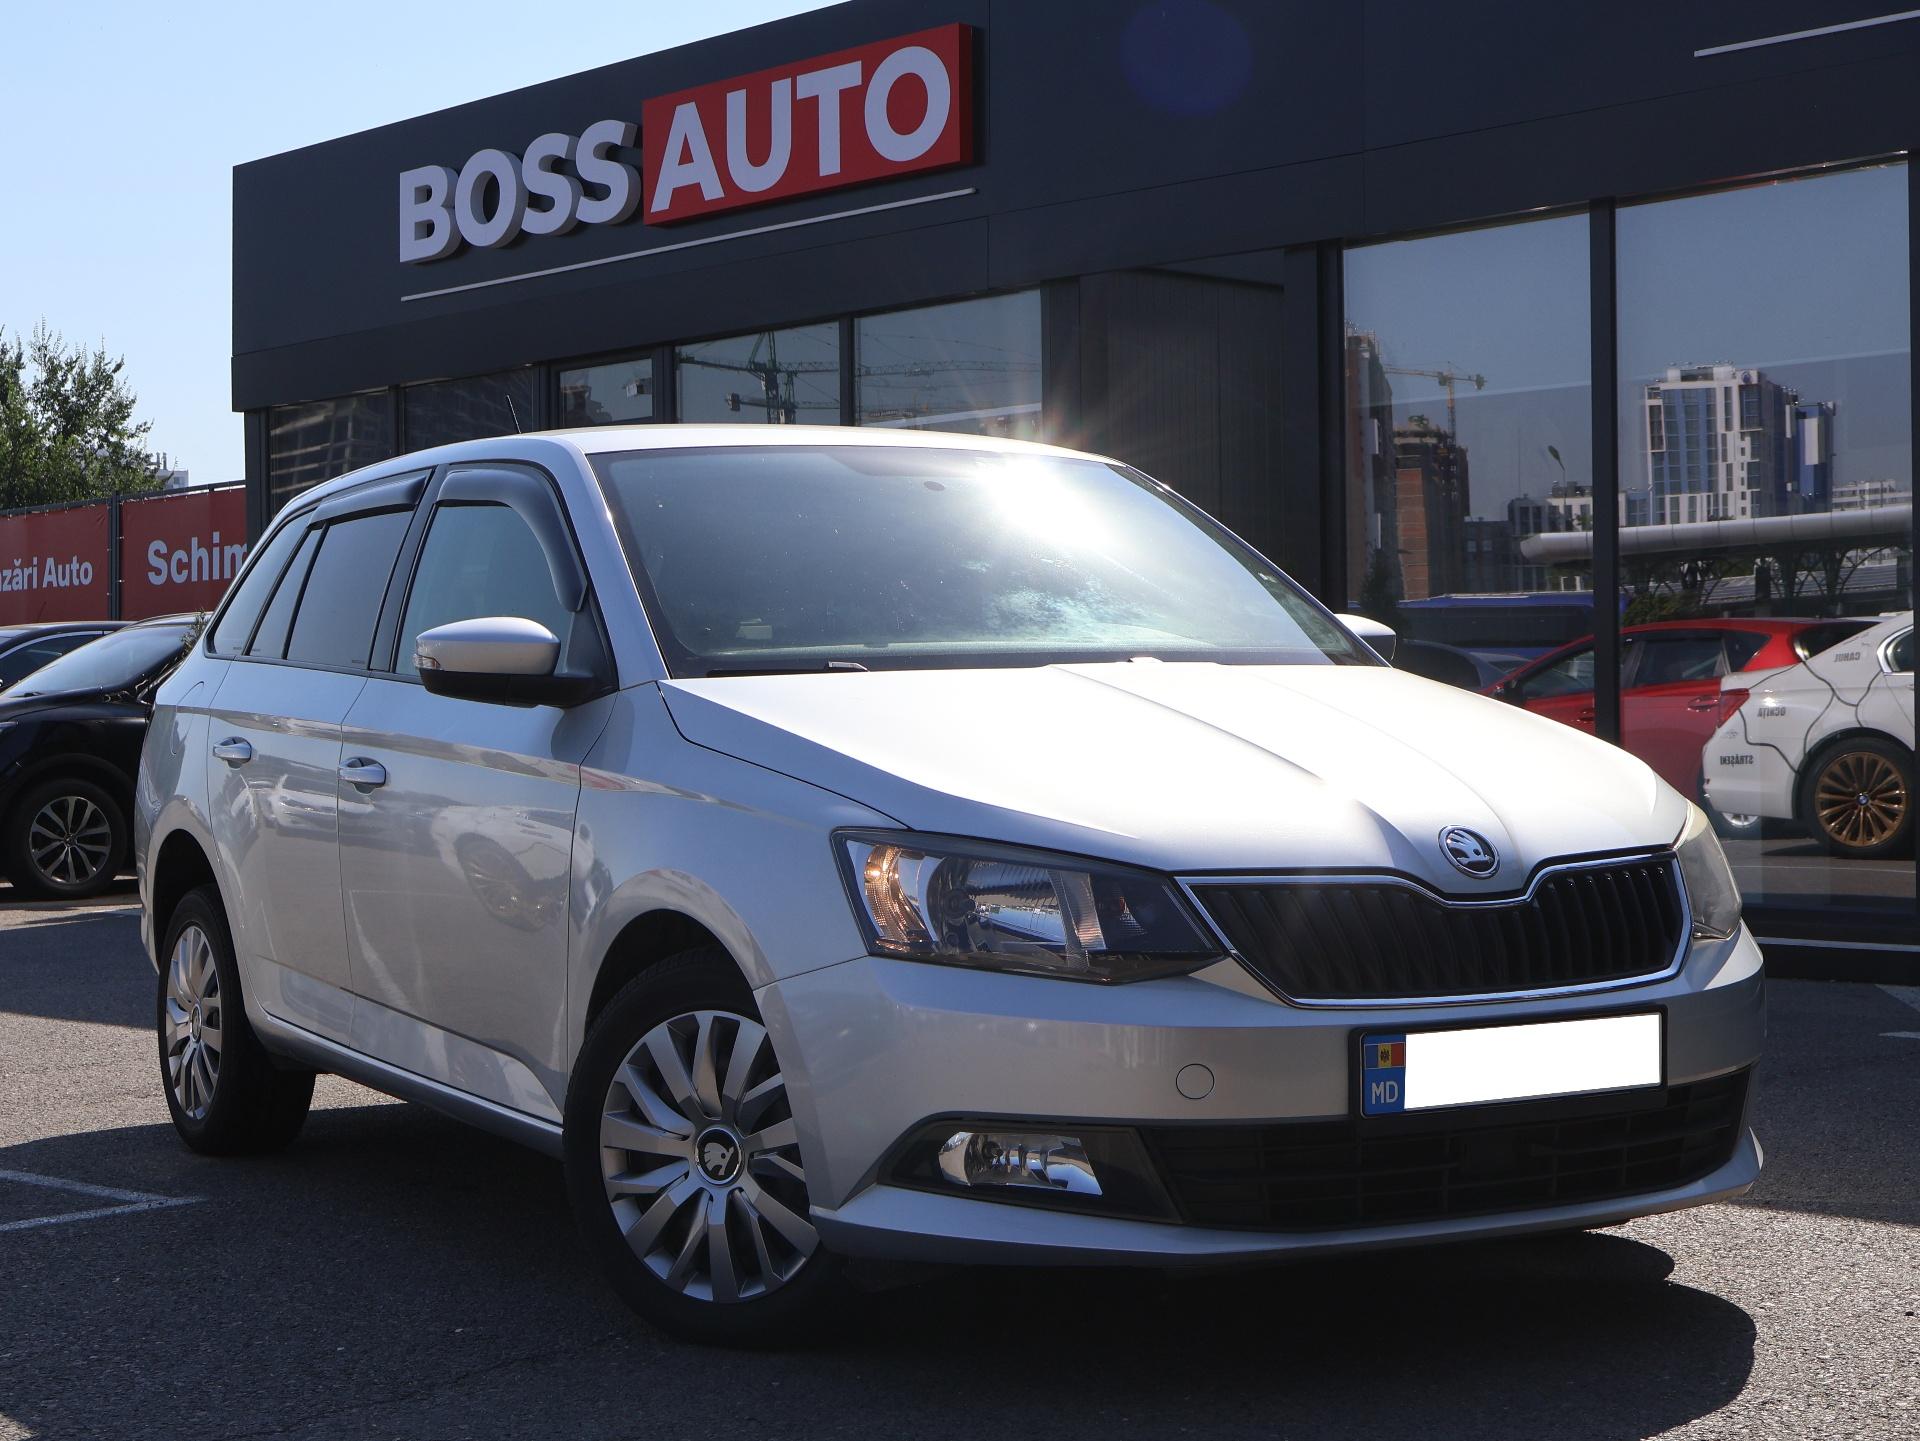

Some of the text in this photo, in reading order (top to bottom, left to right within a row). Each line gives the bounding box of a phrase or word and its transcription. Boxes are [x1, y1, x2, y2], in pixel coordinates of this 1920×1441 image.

[399, 45, 951, 264] BOSS AUTO
[0, 554, 93, 592] zări Auto
[1371, 1080, 1399, 1105] MD
